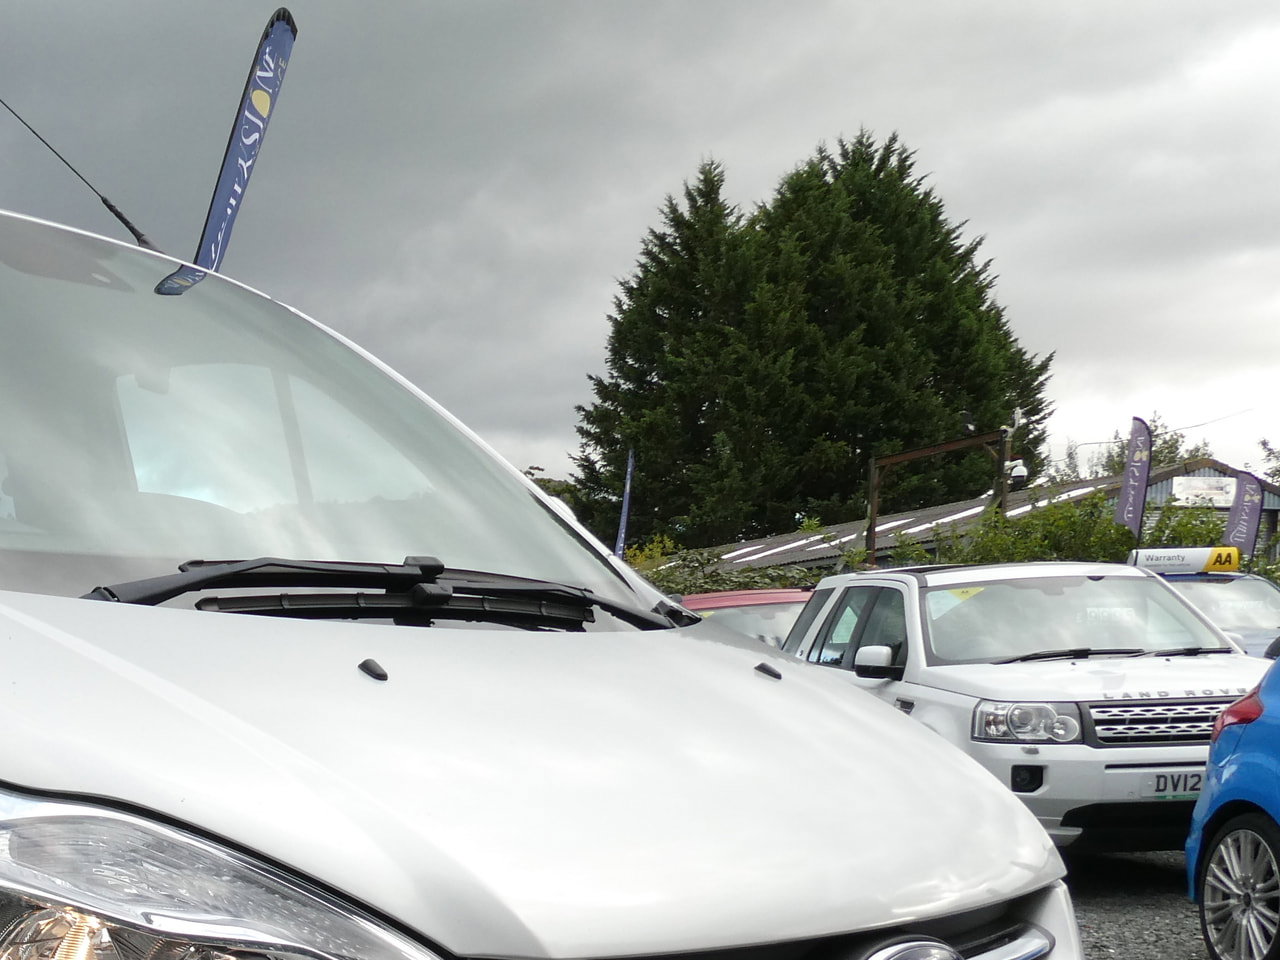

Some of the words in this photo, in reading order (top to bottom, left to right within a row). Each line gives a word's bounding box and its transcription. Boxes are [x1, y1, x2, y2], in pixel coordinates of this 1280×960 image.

[1145, 554, 1186, 562] Warranty
[1212, 552, 1232, 566] AA
[1102, 690, 1170, 699] LAND
[1184, 687, 1249, 696] ROVE
[1155, 774, 1202, 792] DV12
